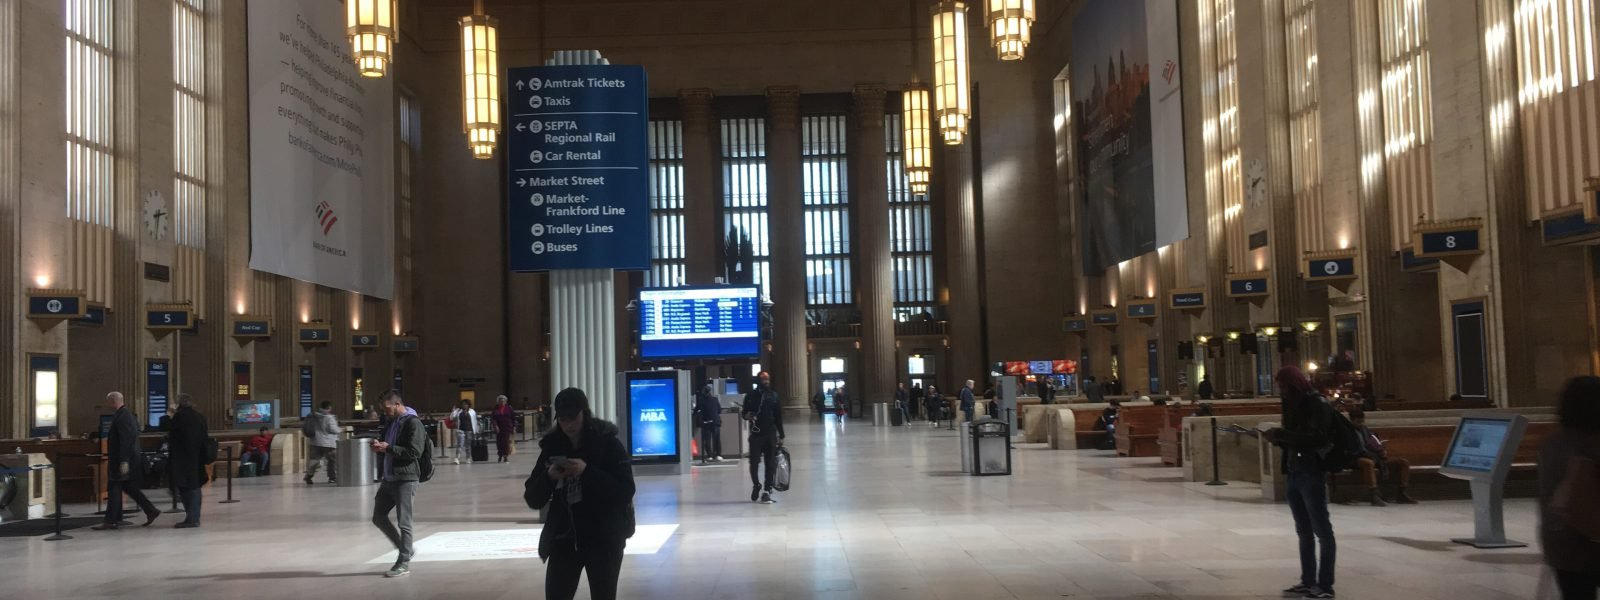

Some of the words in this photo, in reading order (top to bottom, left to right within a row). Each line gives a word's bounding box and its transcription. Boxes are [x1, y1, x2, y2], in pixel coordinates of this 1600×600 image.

[544, 77, 585, 88] Amtrak
[587, 77, 625, 88] Tickets
[544, 96, 571, 106] Taxis
[544, 121, 578, 131] SEPTA
[544, 132, 592, 145] Regional
[595, 132, 616, 142] Rail
[545, 151, 563, 161] Car
[566, 150, 601, 160] Rental
[529, 176, 569, 187] Market
[571, 175, 605, 186] Street
[546, 193, 590, 204] Market-
[546, 205, 599, 216] Frankford
[602, 205, 626, 215] Line
[546, 223, 582, 236] Trolley
[585, 223, 614, 233] Lines
[547, 242, 578, 252] Buses
[1445, 235, 1456, 248] 8
[1245, 281, 1253, 291] 6
[163, 313, 172, 323] 5
[311, 331, 318, 339] 3
[640, 411, 667, 422] MBA
